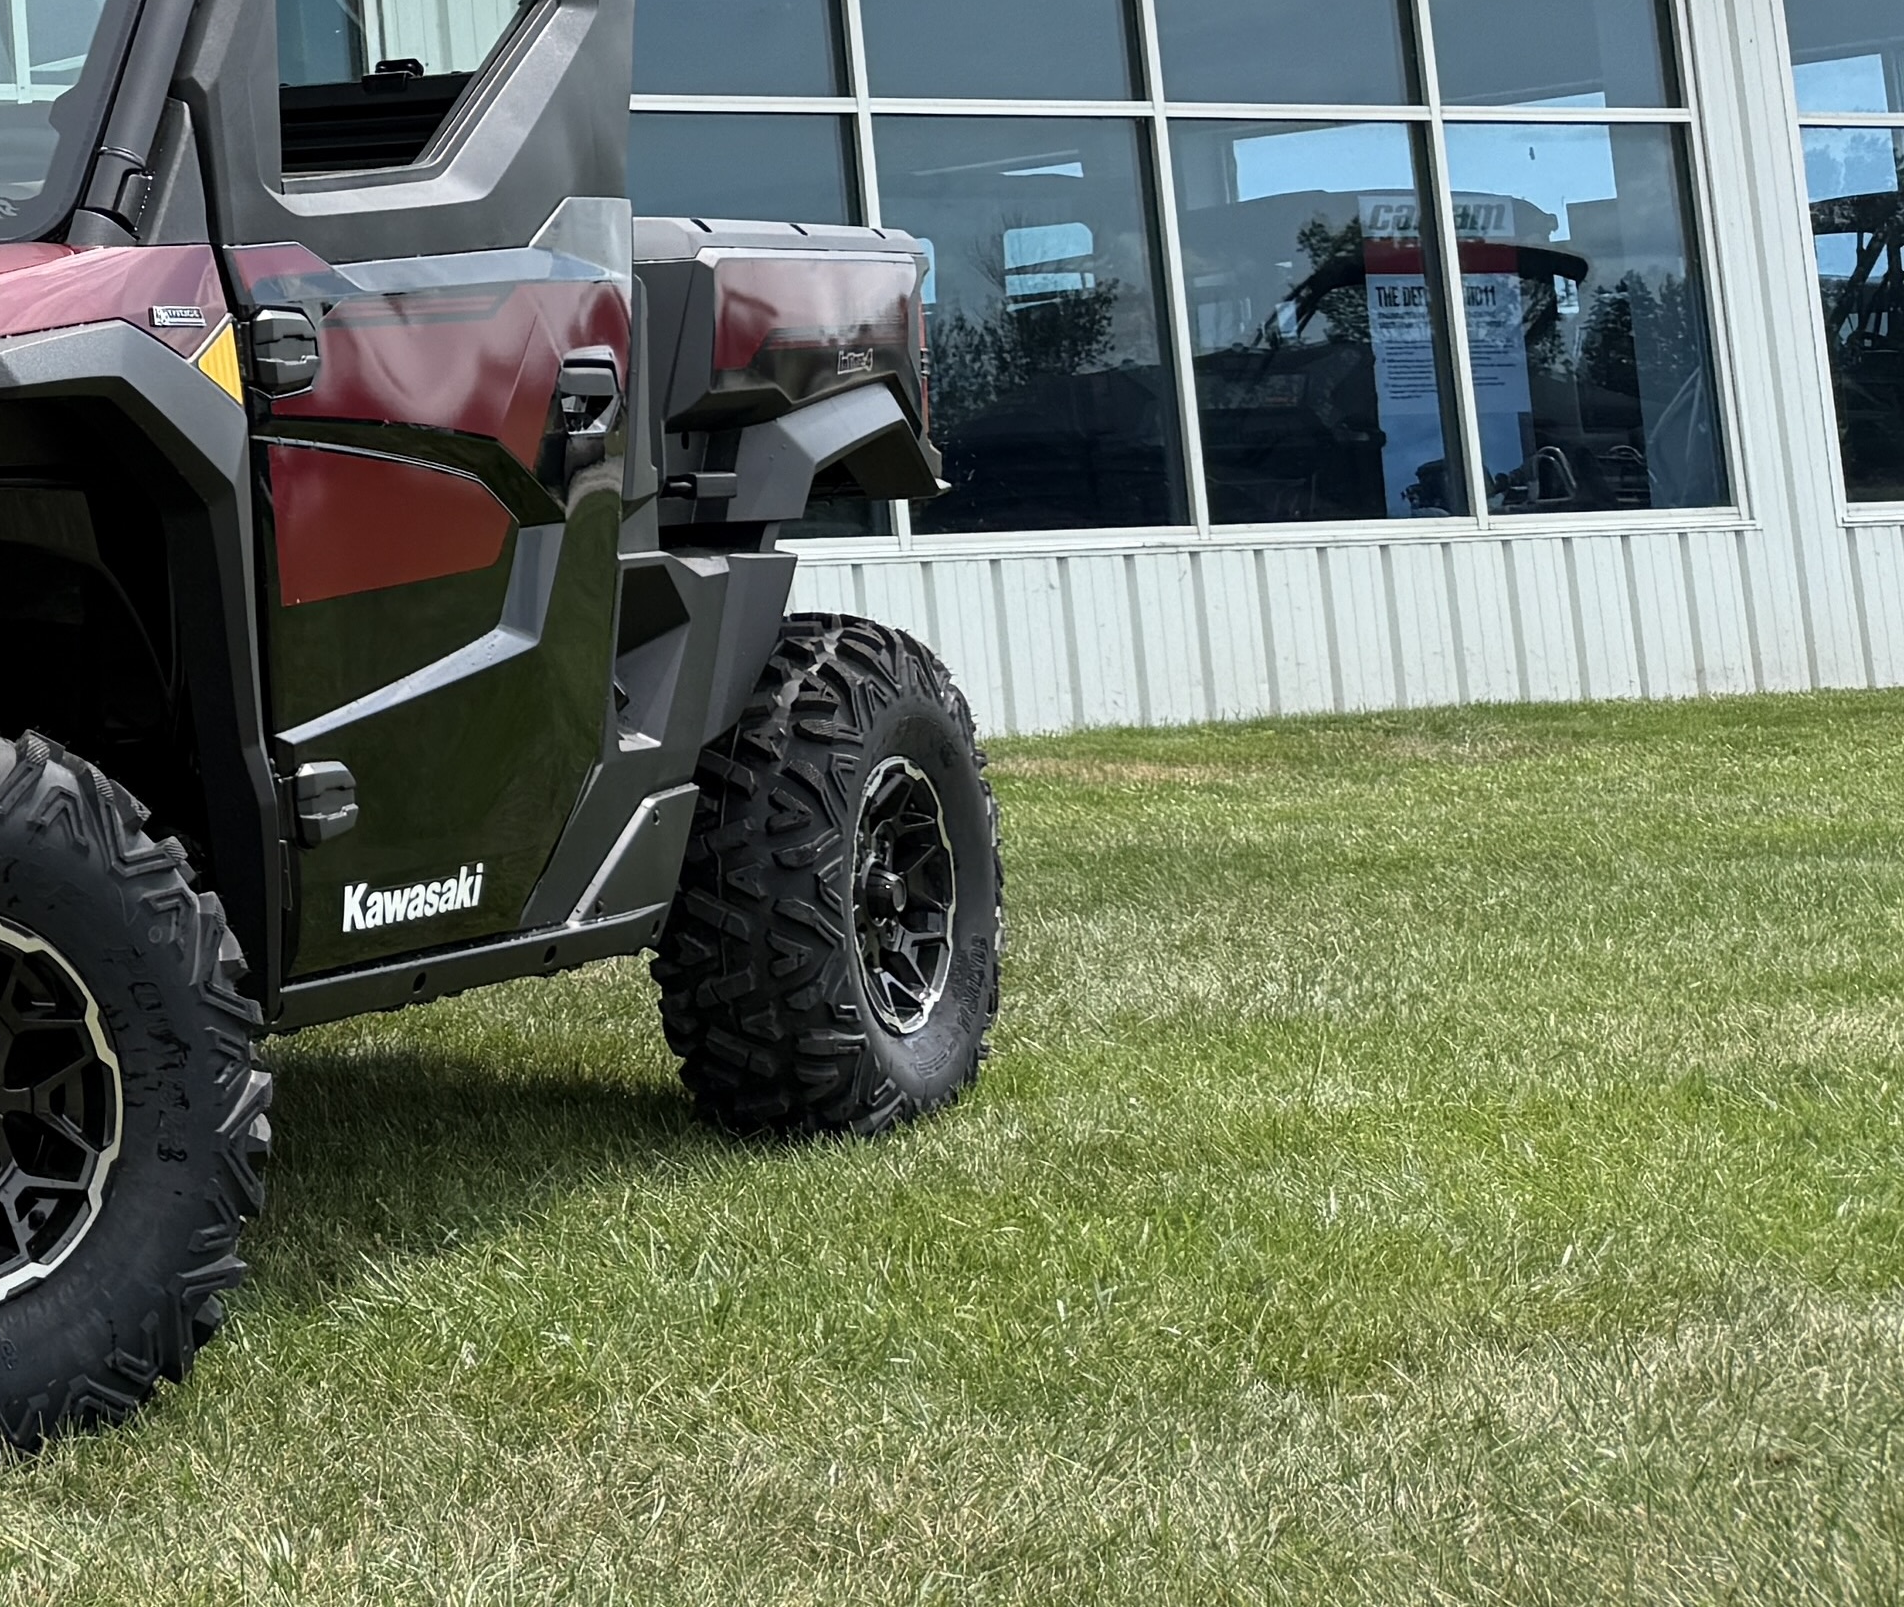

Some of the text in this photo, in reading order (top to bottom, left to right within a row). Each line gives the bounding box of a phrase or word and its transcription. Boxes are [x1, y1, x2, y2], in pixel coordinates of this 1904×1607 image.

[1368, 204, 1506, 232] caam
[1375, 285, 1400, 307] THE
[342, 862, 484, 932] Kawasaki
